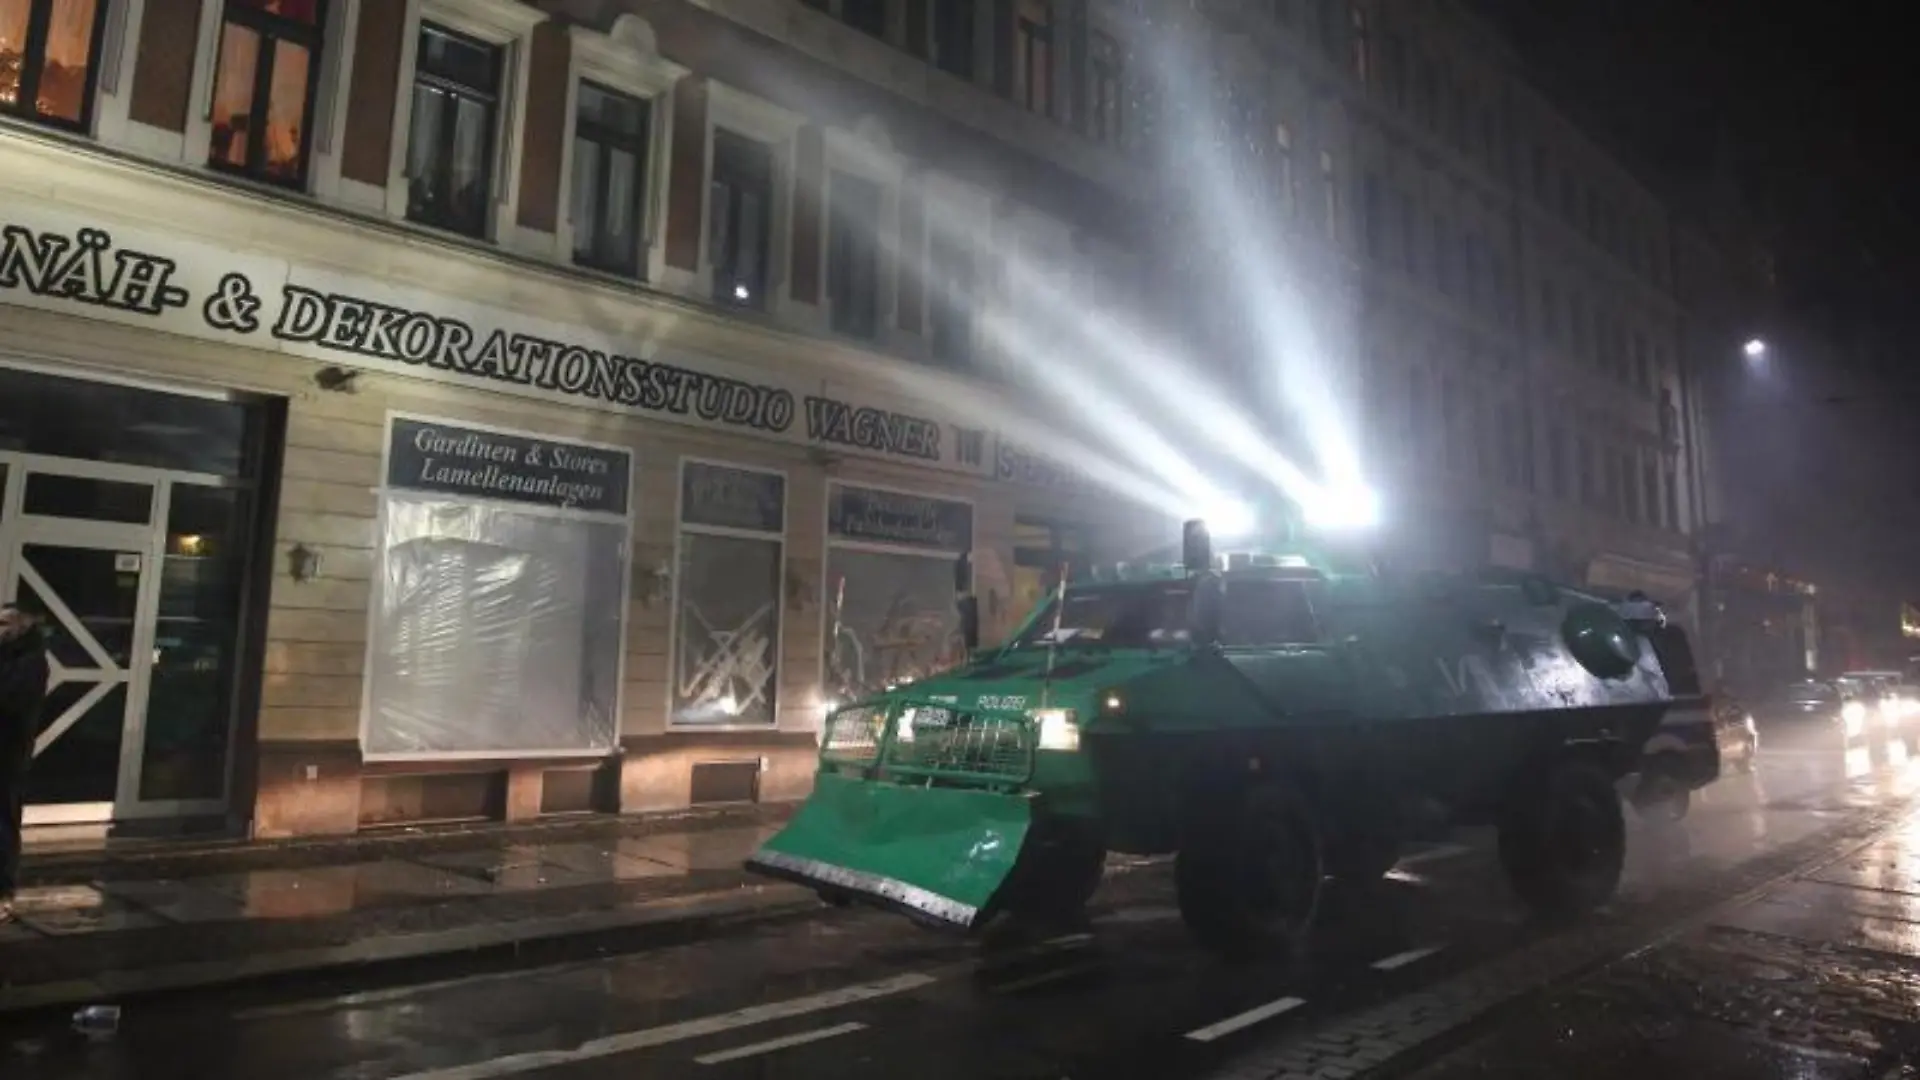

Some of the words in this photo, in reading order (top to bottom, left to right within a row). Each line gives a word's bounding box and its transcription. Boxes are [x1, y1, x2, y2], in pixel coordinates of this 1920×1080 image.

[1, 226, 188, 315] NÄH-
[204, 273, 260, 332] &
[272, 285, 793, 433] DEKORATIONSSTUDIO
[804, 396, 940, 460] WAGNER
[414, 427, 517, 462] Gardinen
[525, 444, 544, 467] &
[548, 447, 609, 475] Stores
[420, 458, 605, 505] Lamellenanlagen
